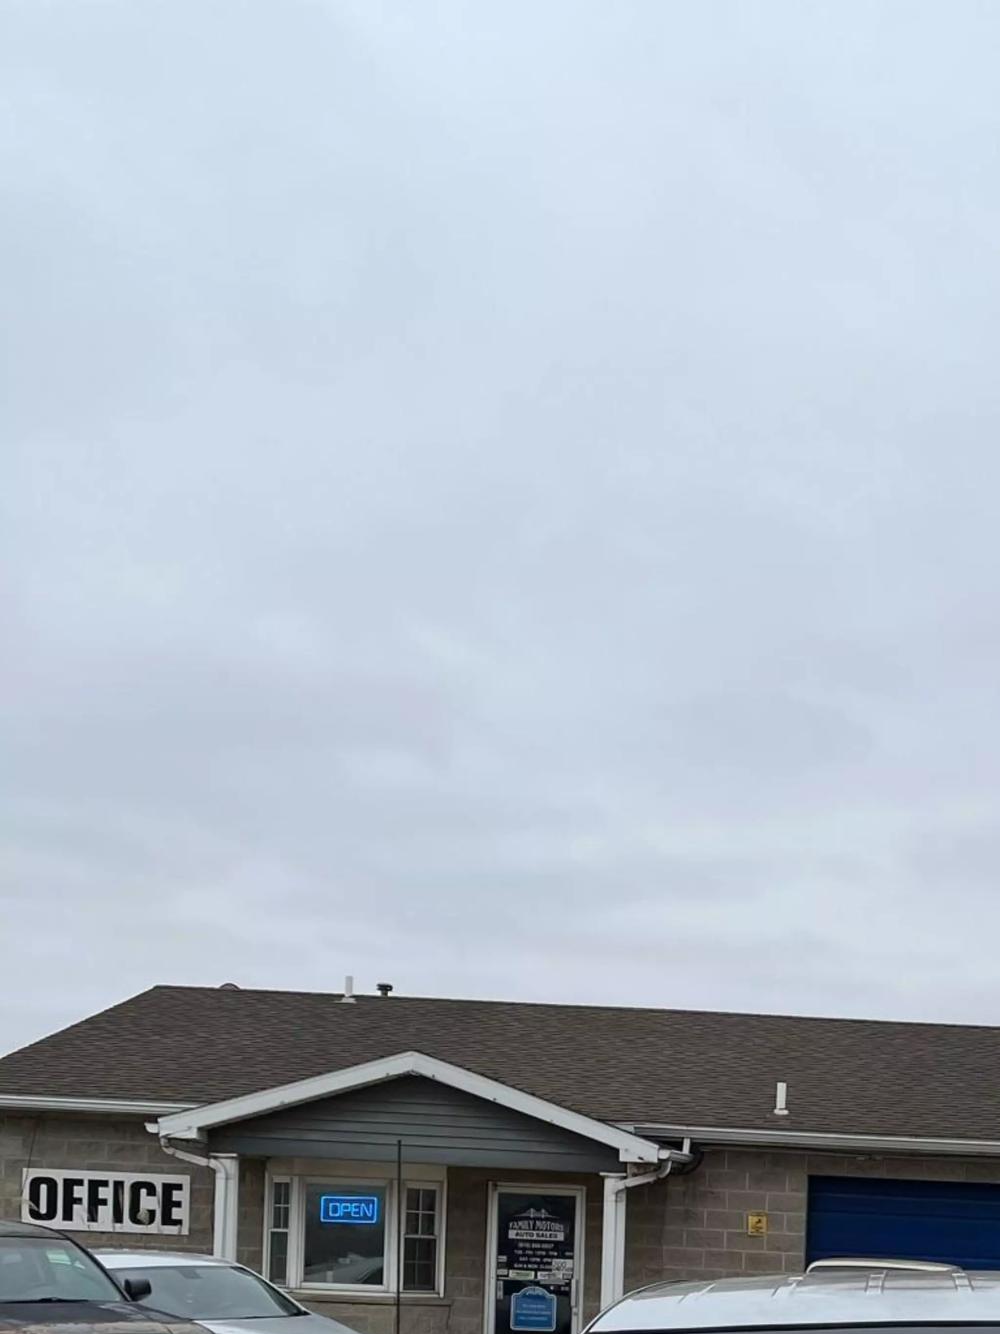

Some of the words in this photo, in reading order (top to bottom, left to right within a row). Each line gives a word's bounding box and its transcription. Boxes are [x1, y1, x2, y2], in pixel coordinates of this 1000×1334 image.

[28, 1176, 184, 1227] OFFICE
[328, 1202, 373, 1217] OPEN
[509, 1219, 534, 1231] FAMILY
